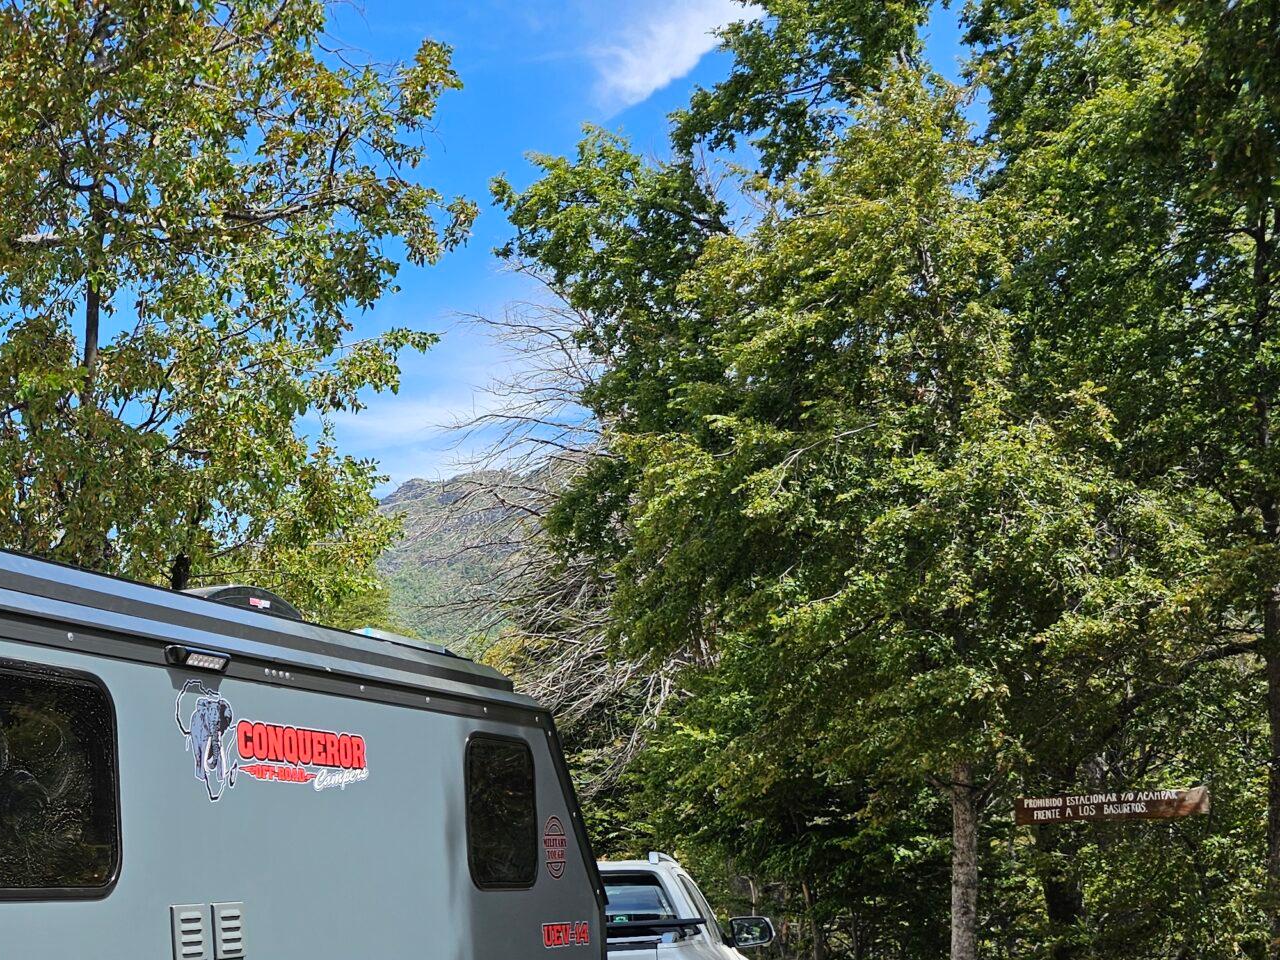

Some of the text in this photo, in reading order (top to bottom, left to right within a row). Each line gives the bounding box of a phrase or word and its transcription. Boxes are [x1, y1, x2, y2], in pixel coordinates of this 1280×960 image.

[237, 720, 367, 769] CONQUEROR
[255, 764, 306, 782] OFF-ROAD
[313, 767, 370, 791] Campers
[1024, 797, 1063, 808] PROHIBIDO
[1066, 793, 1117, 806] ESTACIONAR
[1120, 792, 1134, 801] Y/O
[1033, 808, 1061, 820] FRENTE
[1065, 807, 1073, 817] A
[1079, 805, 1096, 816] LOS
[542, 921, 590, 948] UEV-14
